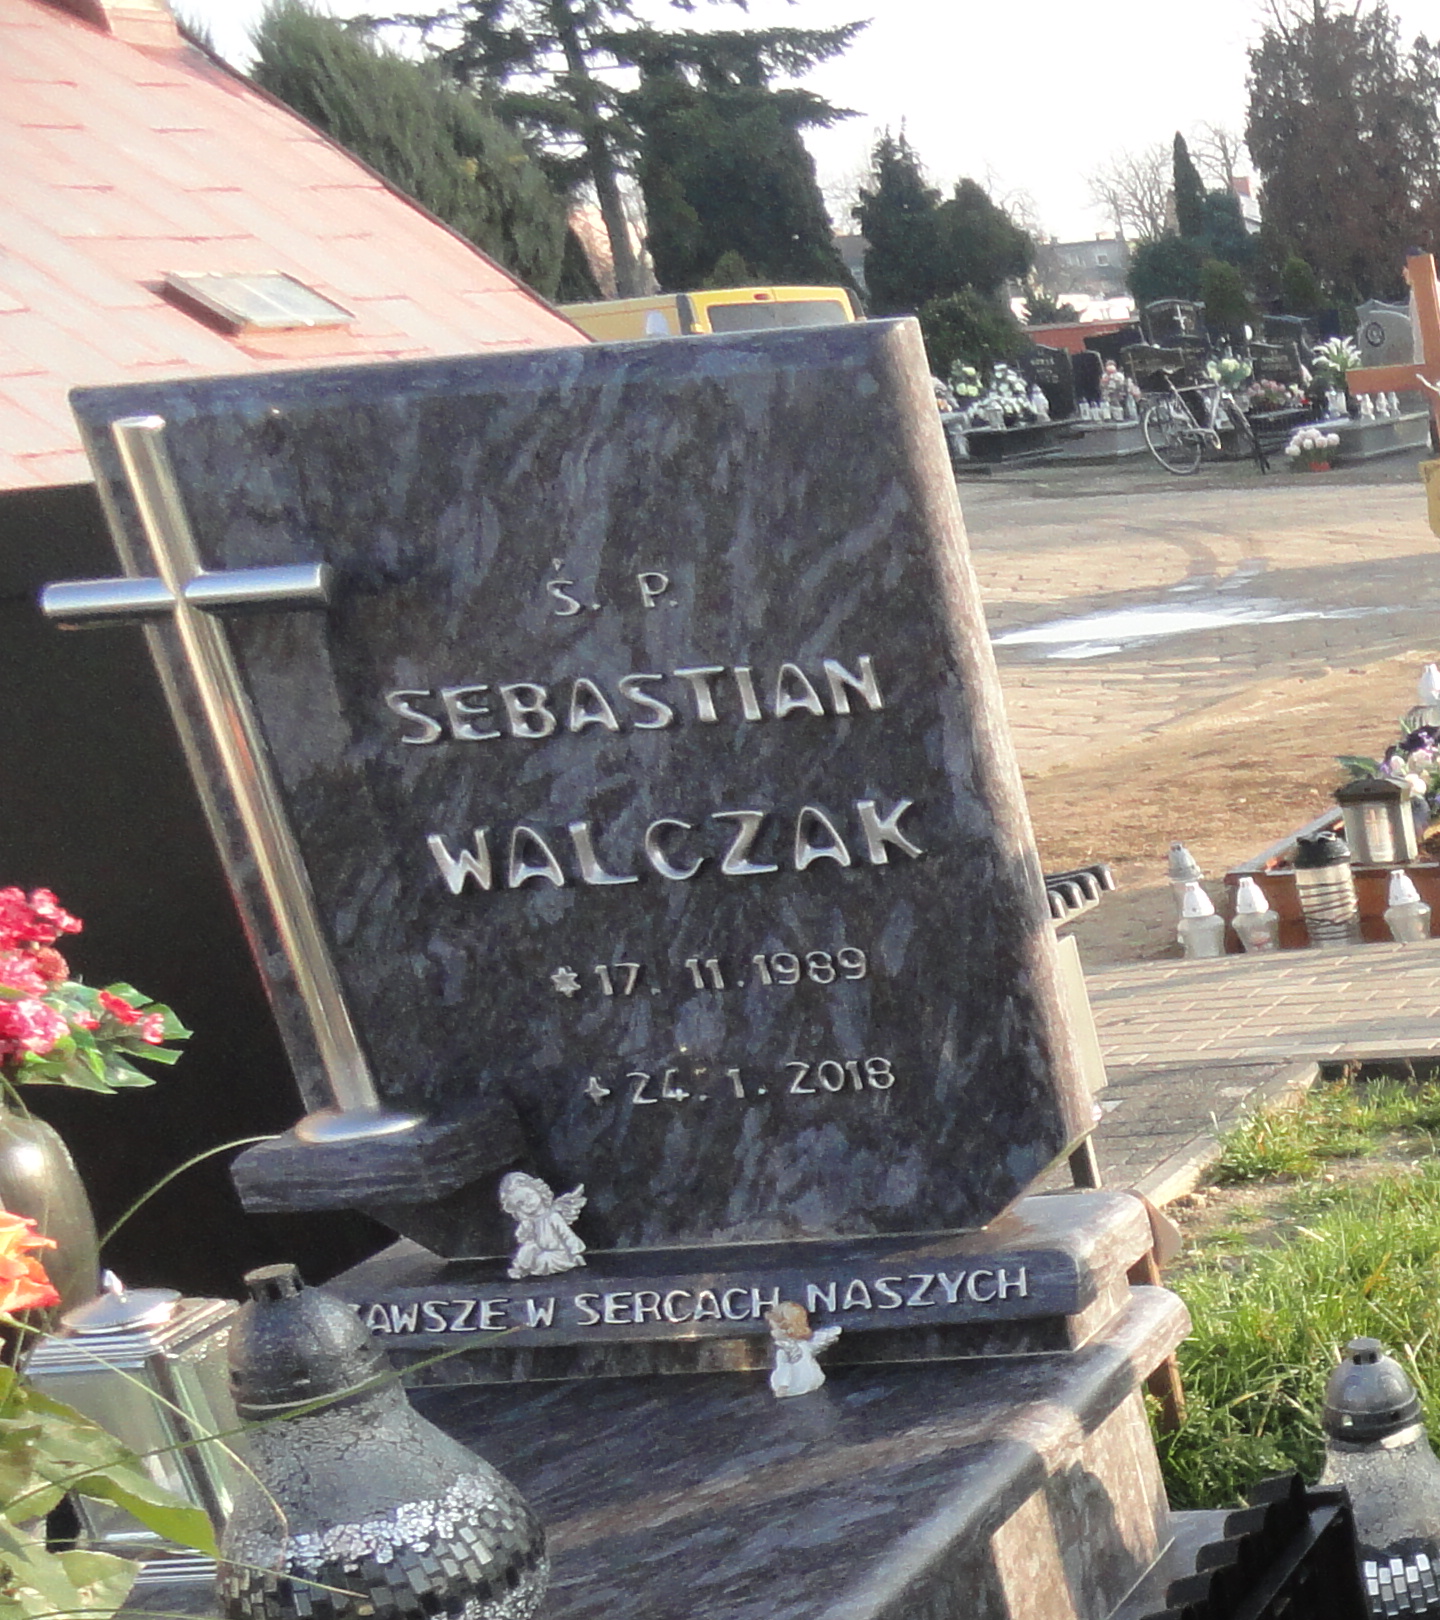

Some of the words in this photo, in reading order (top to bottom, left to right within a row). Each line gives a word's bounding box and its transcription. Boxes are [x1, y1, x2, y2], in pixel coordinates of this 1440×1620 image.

[385, 655, 885, 744] SEBASTIAN
[426, 801, 924, 896] WALCZAK
[786, 1057, 895, 1094] 2018
[347, 1299, 509, 1333] AWSZE
[524, 1297, 555, 1328] W
[574, 1286, 780, 1327] SERCACH
[806, 1267, 1029, 1314] NASZYCH
